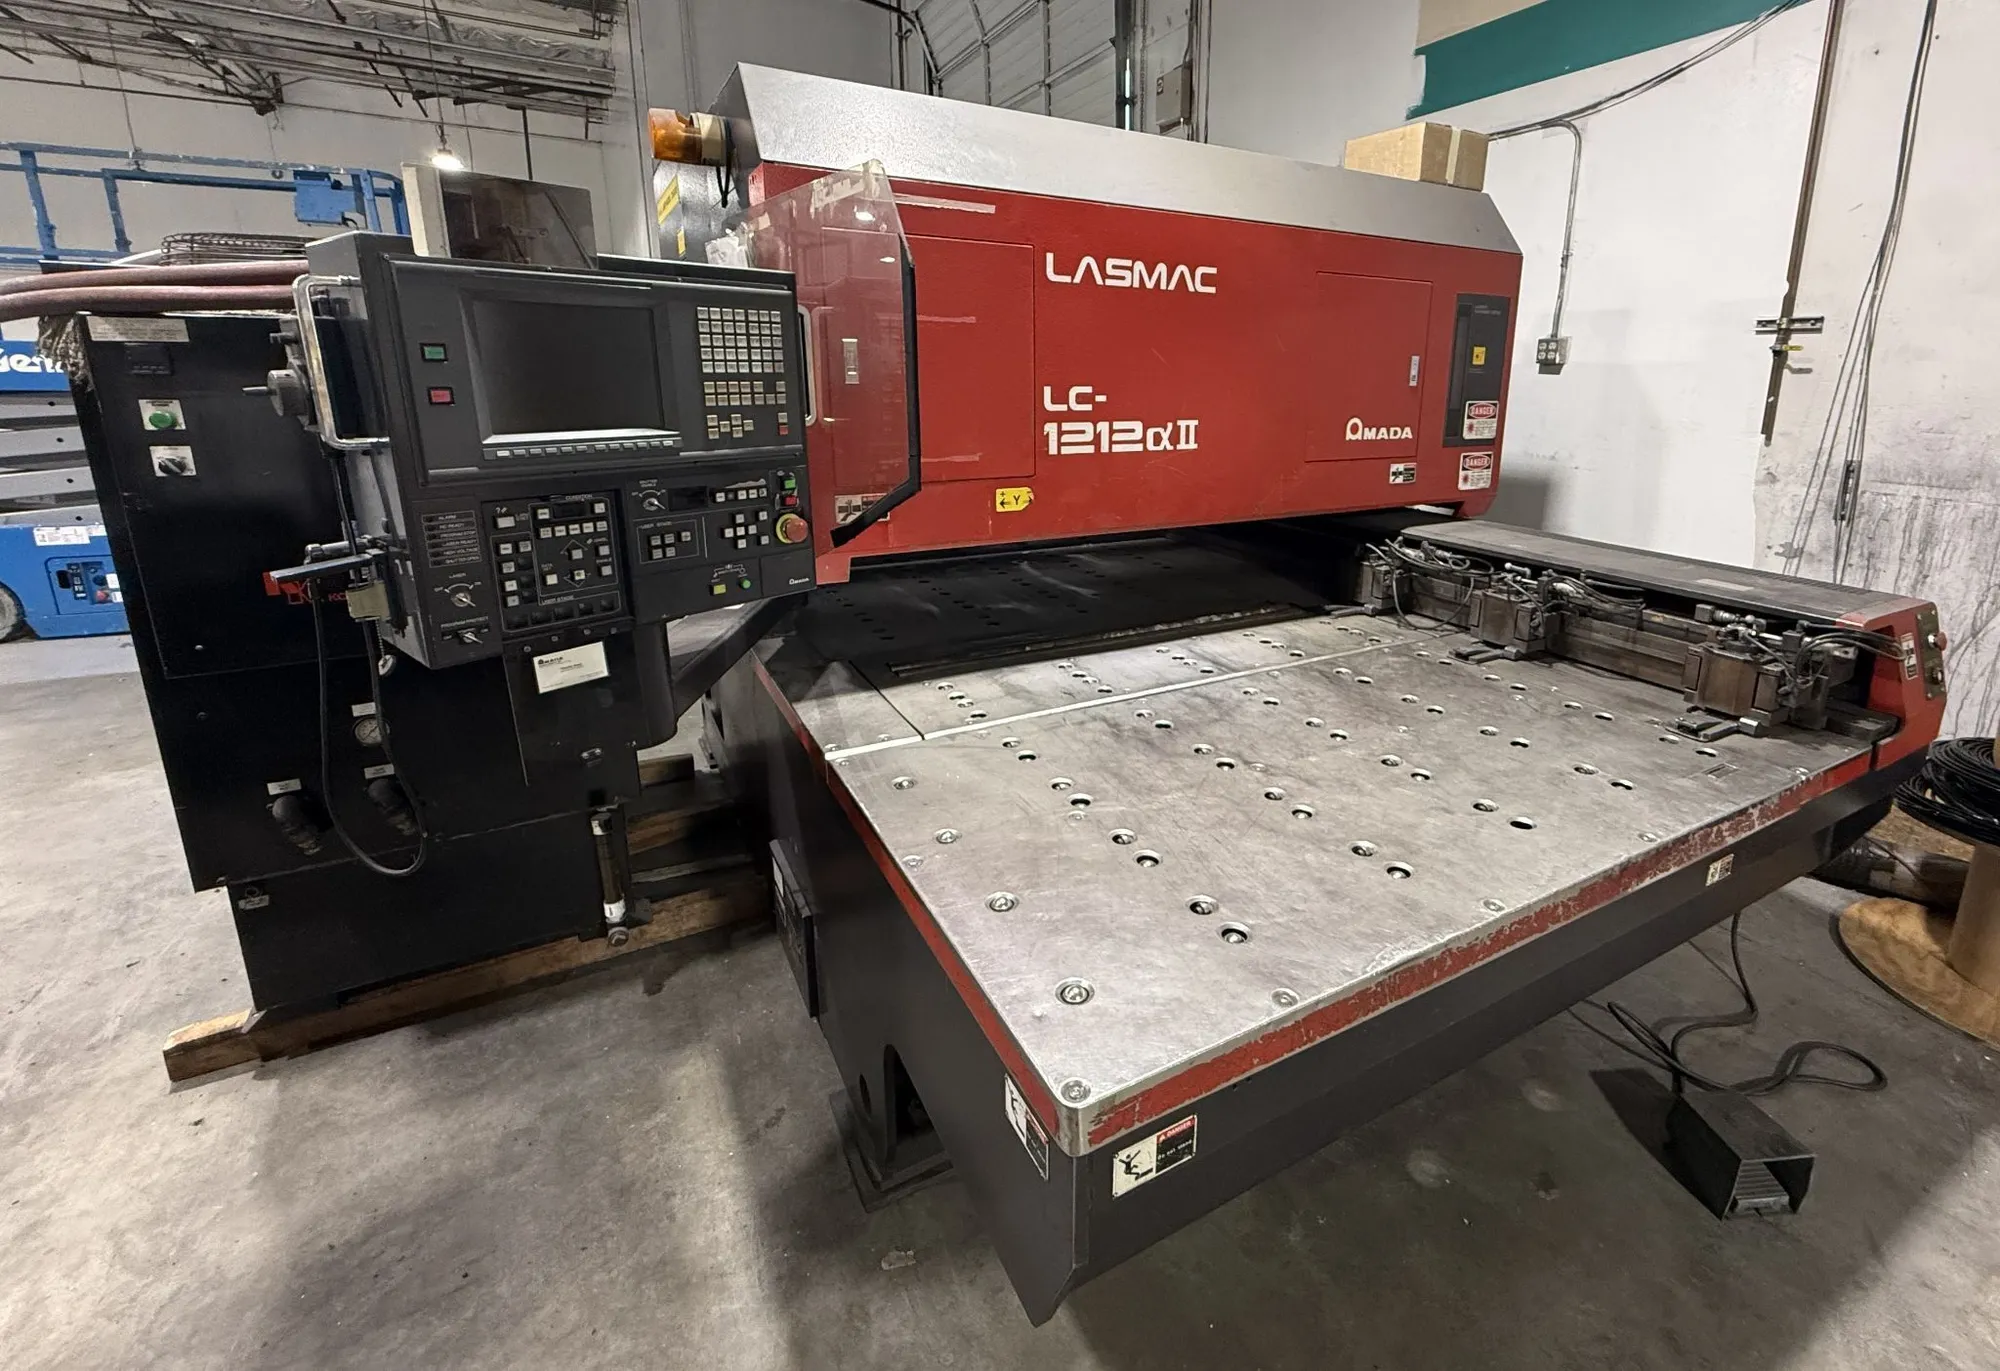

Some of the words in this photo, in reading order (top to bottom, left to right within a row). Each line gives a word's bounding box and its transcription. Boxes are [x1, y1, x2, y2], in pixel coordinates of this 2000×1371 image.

[1045, 252, 1218, 294] LASMAC
[1043, 385, 1107, 412] LC-
[1471, 406, 1494, 415] DANGER
[1345, 417, 1414, 442] AMADA
[1466, 457, 1489, 468] DANGER
[1166, 1120, 1192, 1138] DANGER
